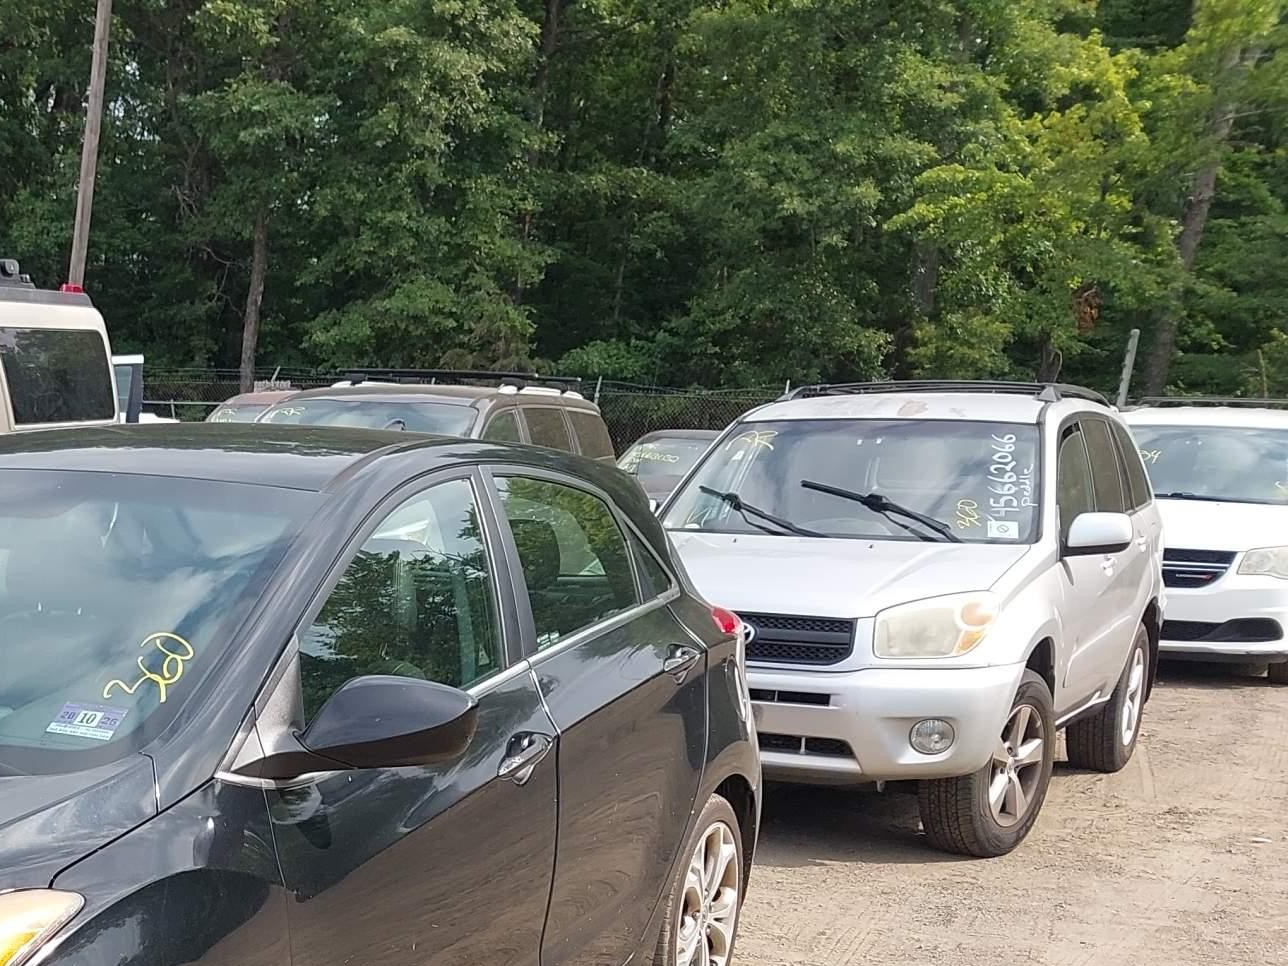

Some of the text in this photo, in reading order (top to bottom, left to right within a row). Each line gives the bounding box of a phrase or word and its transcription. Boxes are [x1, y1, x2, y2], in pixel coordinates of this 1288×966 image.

[987, 433, 1019, 517] 45662066
[103, 631, 195, 703] 360
[77, 712, 98, 725] 10
